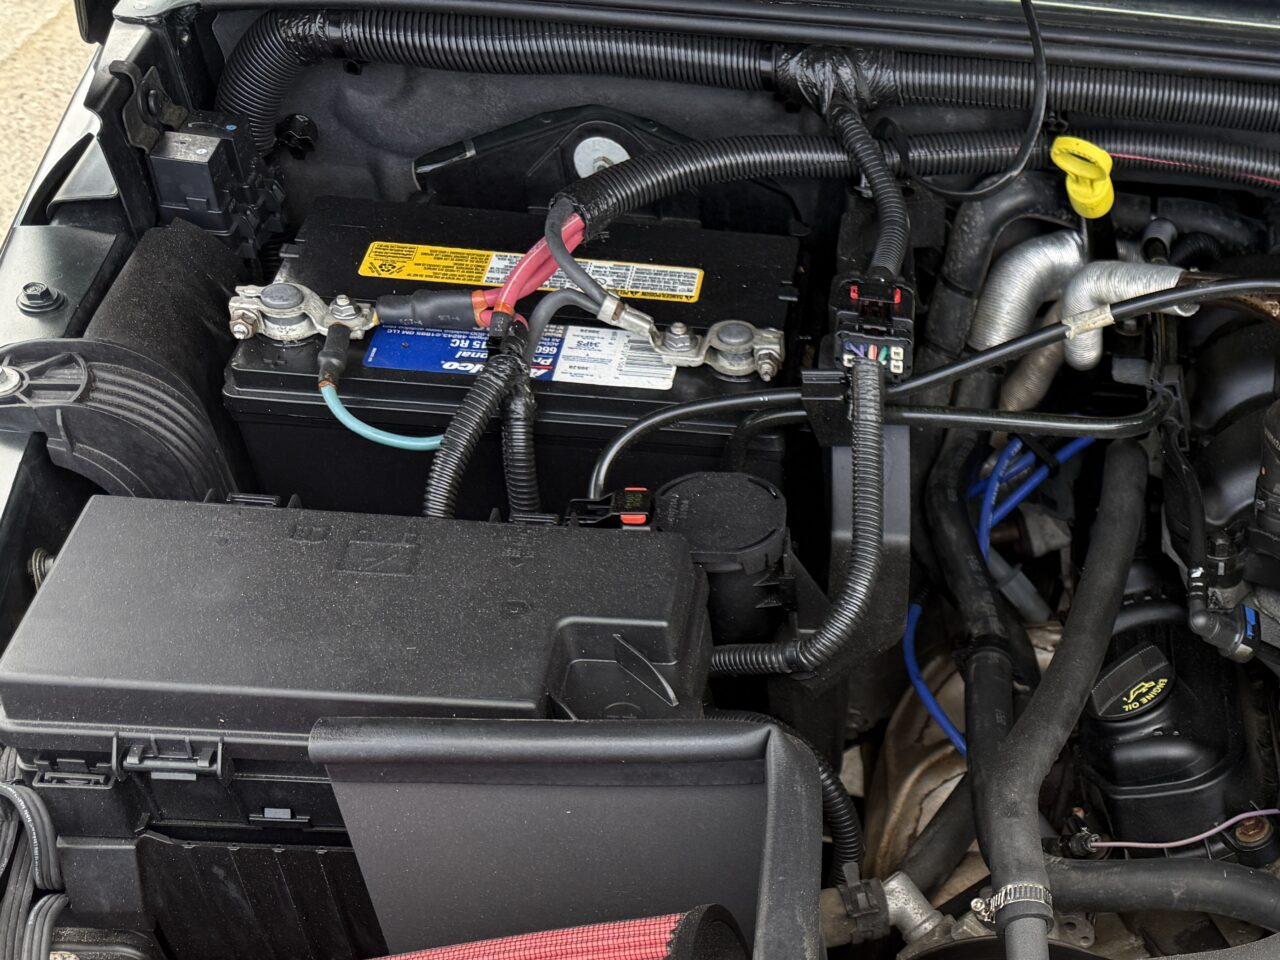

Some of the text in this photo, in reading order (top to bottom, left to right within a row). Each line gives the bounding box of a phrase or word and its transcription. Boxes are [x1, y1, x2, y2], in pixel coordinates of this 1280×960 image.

[450, 338, 470, 348] RC
[1122, 678, 1168, 711] ENGINE OIL
